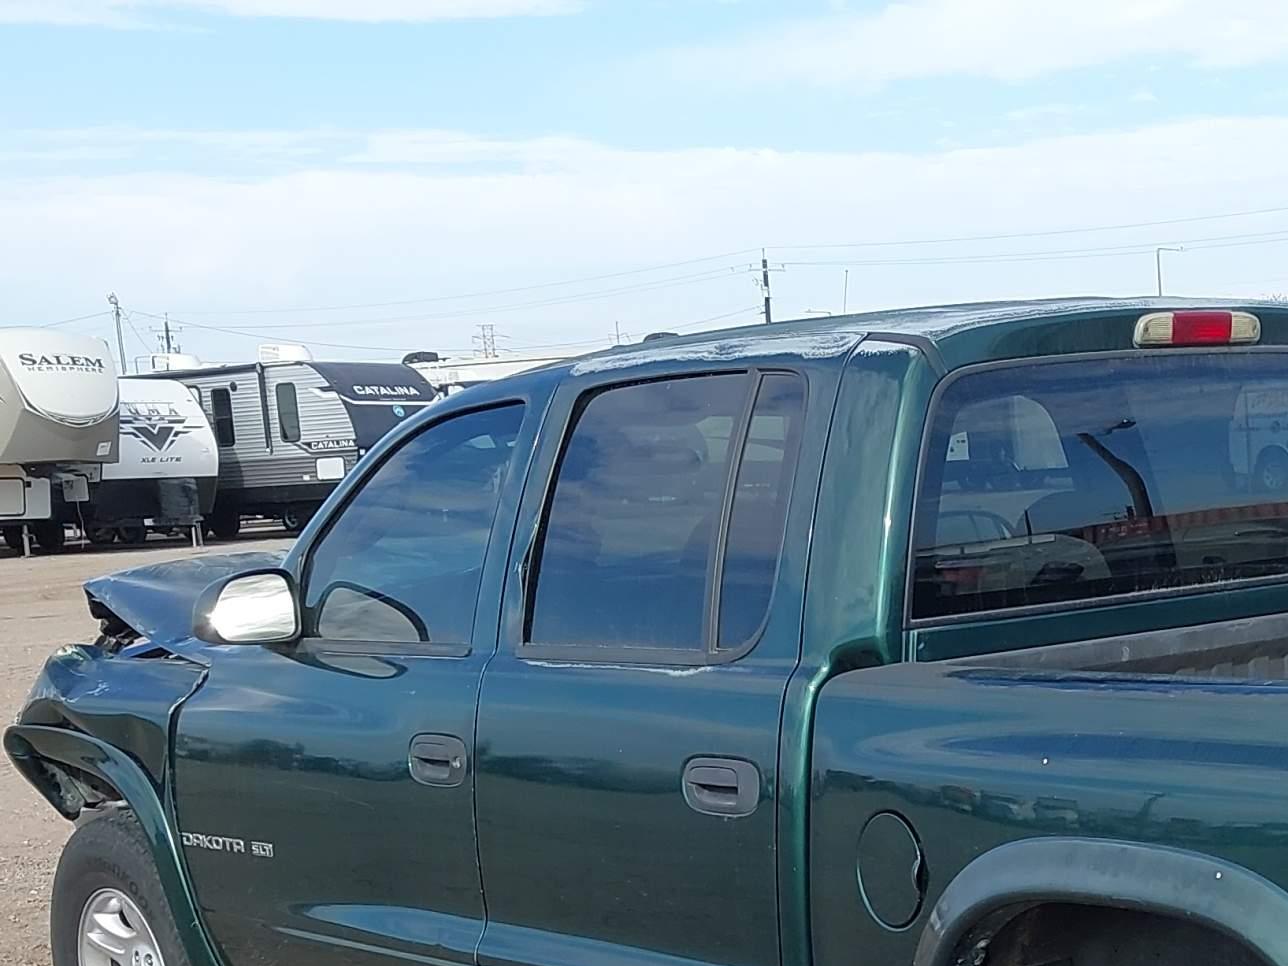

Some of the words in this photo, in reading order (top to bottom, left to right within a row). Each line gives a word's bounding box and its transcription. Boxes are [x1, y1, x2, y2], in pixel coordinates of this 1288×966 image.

[19, 353, 105, 368] SALEM
[352, 385, 420, 396] CATALINA
[311, 440, 355, 449] CATALINA
[181, 832, 245, 853] DAKOTA
[251, 841, 273, 857] SLT
